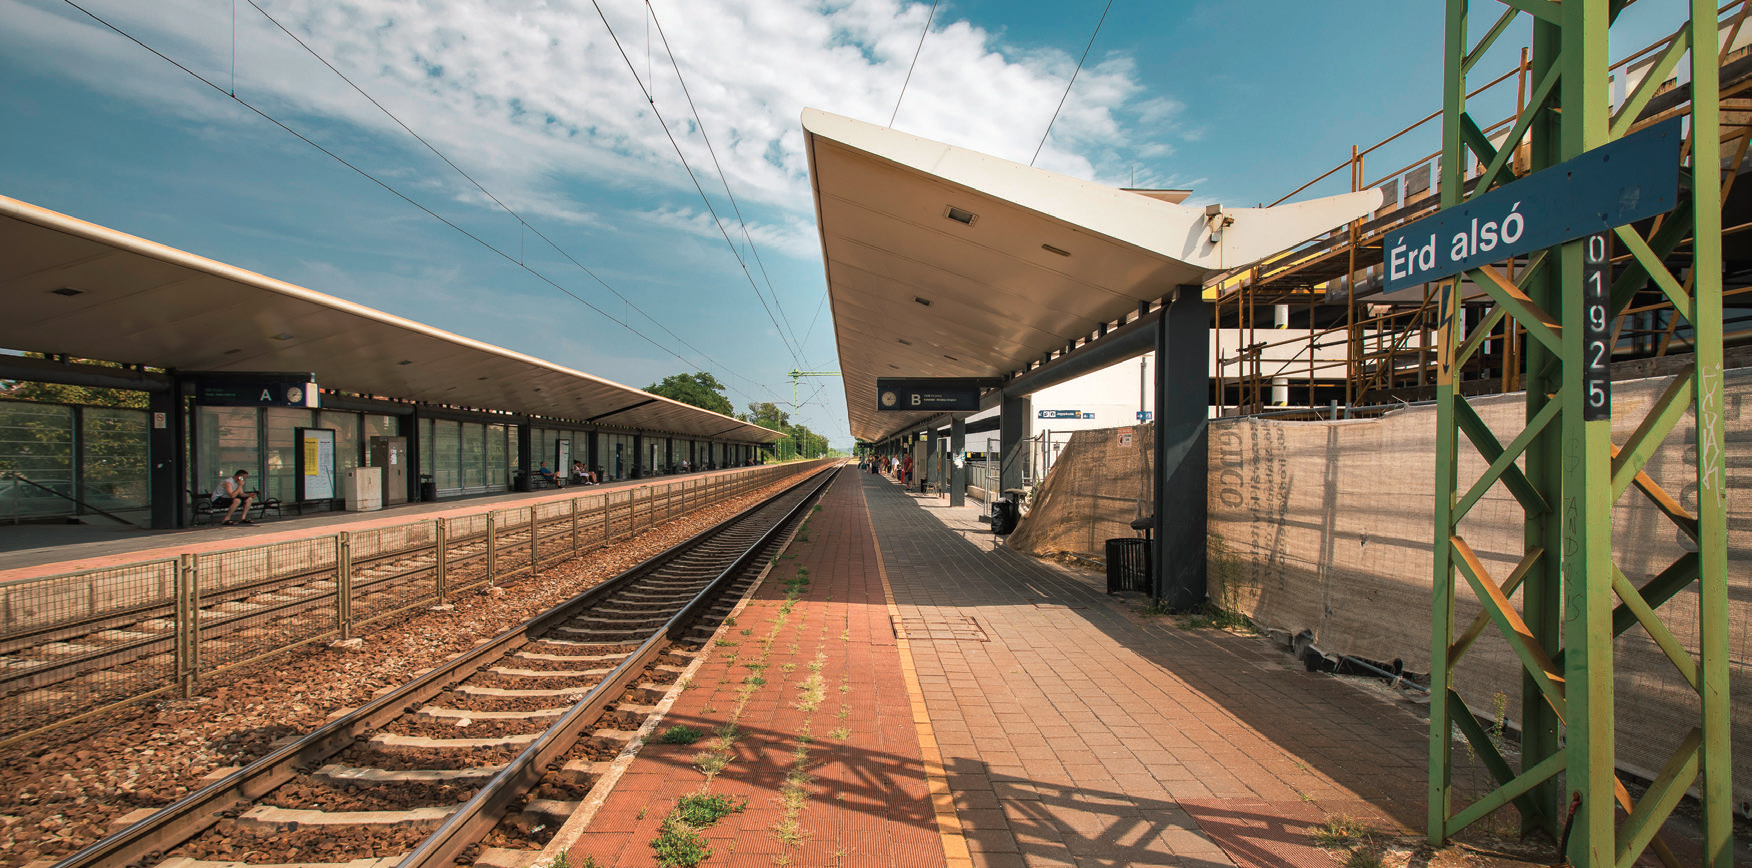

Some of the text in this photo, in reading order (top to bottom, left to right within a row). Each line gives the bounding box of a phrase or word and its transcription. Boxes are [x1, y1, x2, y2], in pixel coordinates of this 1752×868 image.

[1390, 201, 1524, 281] Érd alsó
[1588, 235, 1606, 408] 01925
[260, 389, 272, 401] A
[911, 394, 921, 406] B
